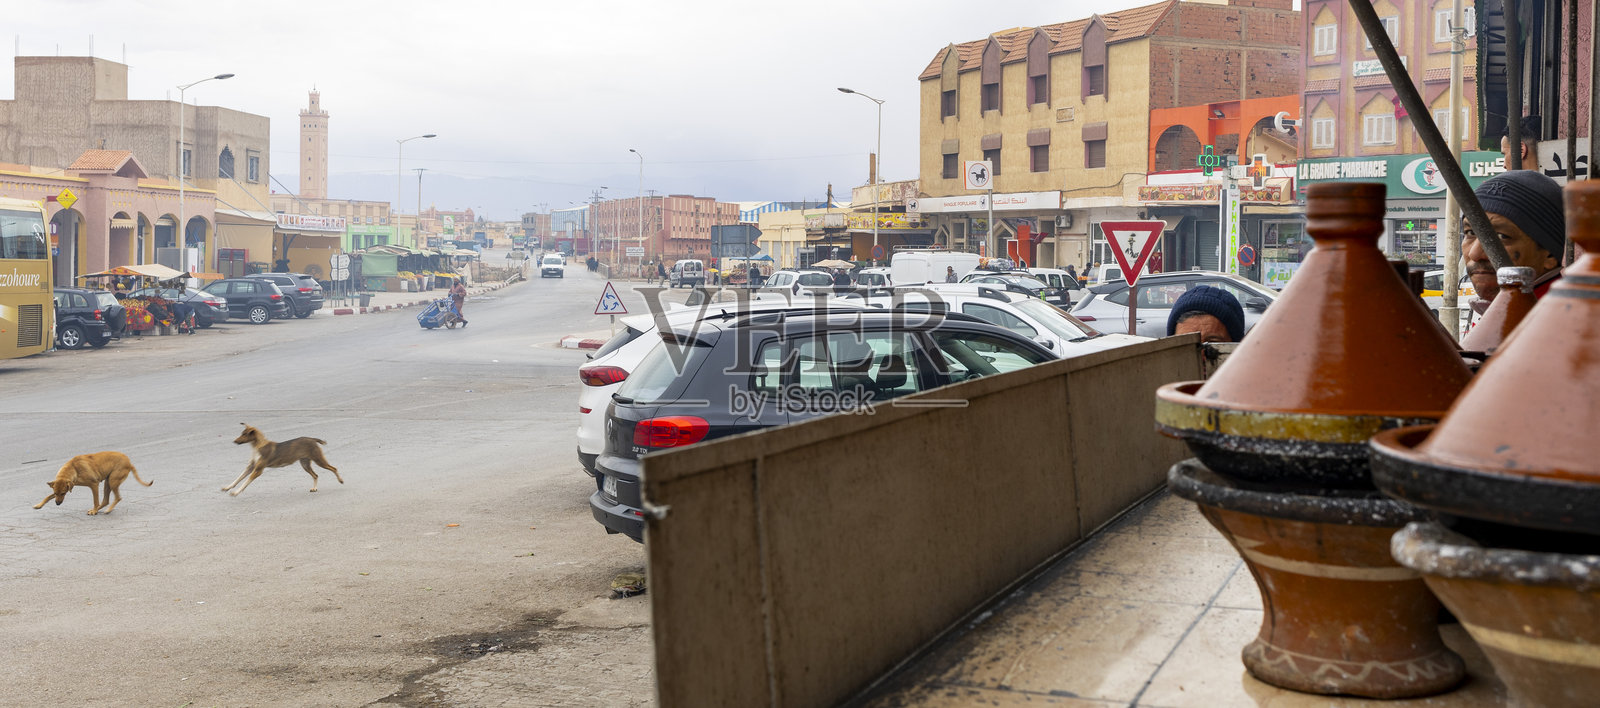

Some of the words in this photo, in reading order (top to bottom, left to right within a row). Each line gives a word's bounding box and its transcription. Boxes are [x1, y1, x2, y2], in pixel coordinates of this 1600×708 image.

[1299, 163, 1309, 180] LA
[1309, 162, 1341, 180] GRANDE
[1341, 160, 1387, 178] PHARMACIE
